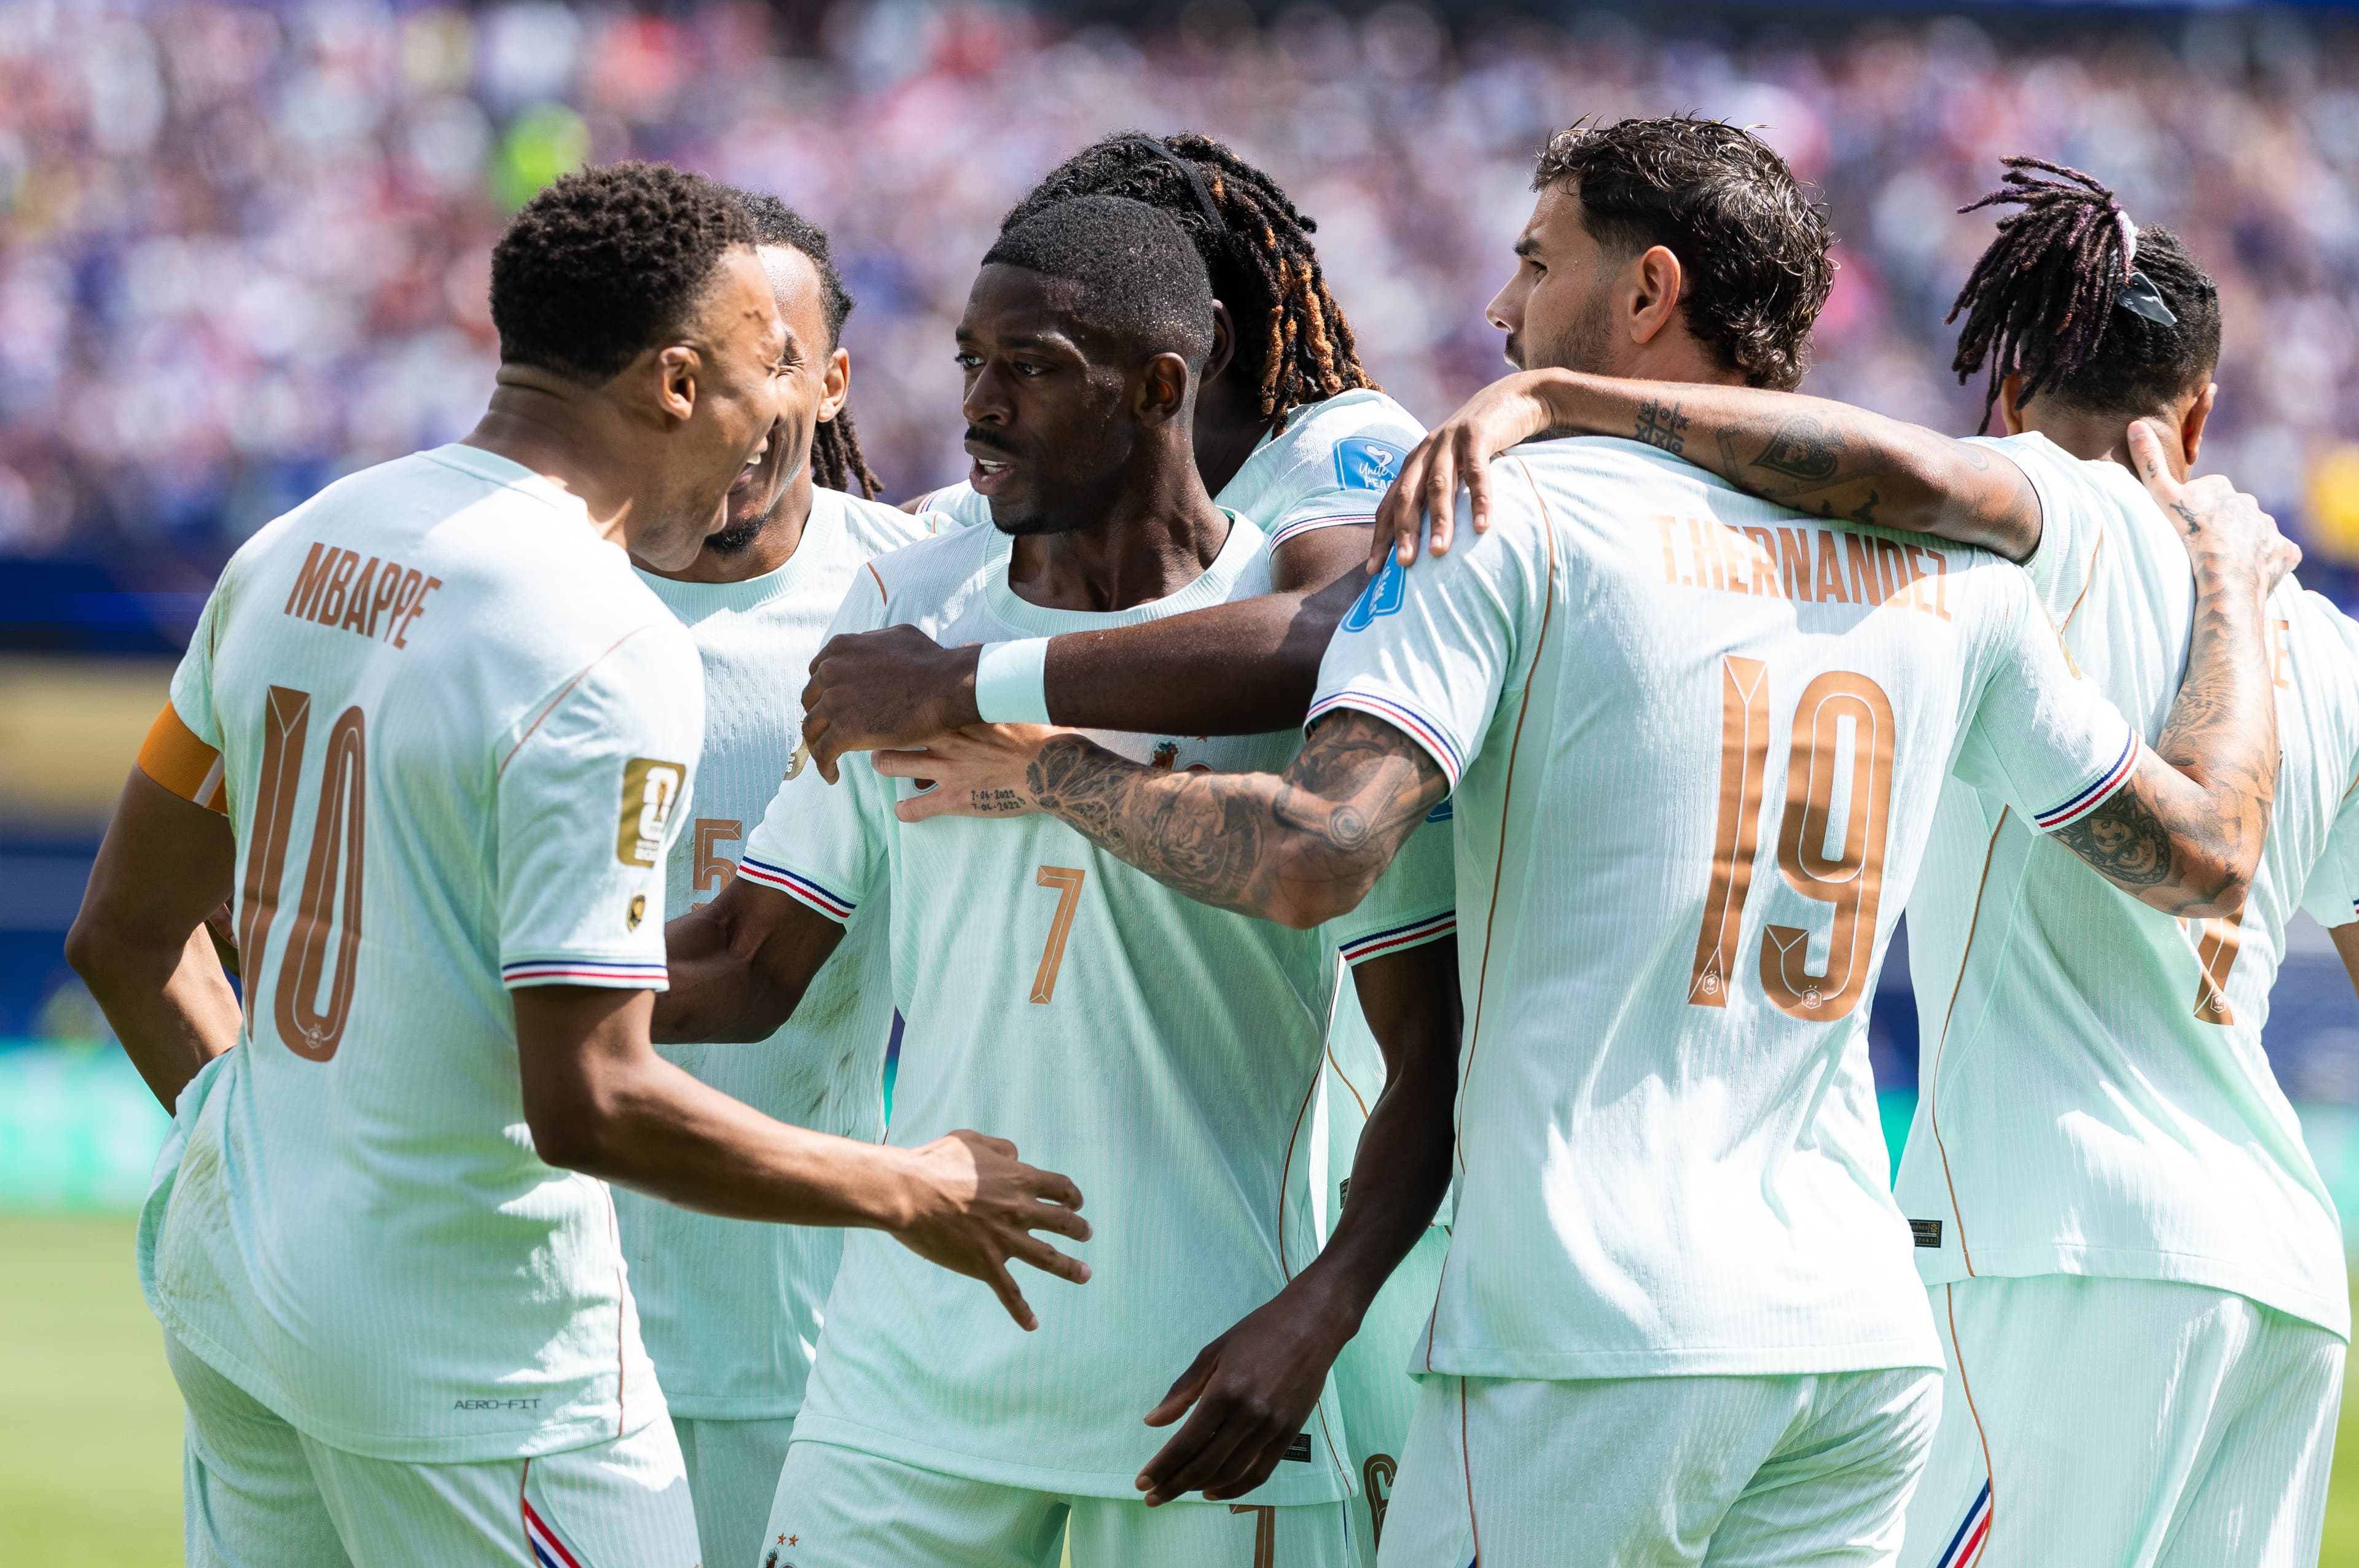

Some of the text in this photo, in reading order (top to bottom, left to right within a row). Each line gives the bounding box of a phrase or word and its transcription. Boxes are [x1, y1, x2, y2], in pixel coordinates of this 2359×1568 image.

[284, 541, 442, 650] MBAPPE
[1649, 513, 1952, 622] T.HERNANDEZ
[239, 684, 366, 1063] 10
[692, 817, 743, 913] 5
[1688, 654, 1896, 1022] 19
[1029, 864, 1086, 1005] 7
[453, 1398, 541, 1410] AERO-FIT
